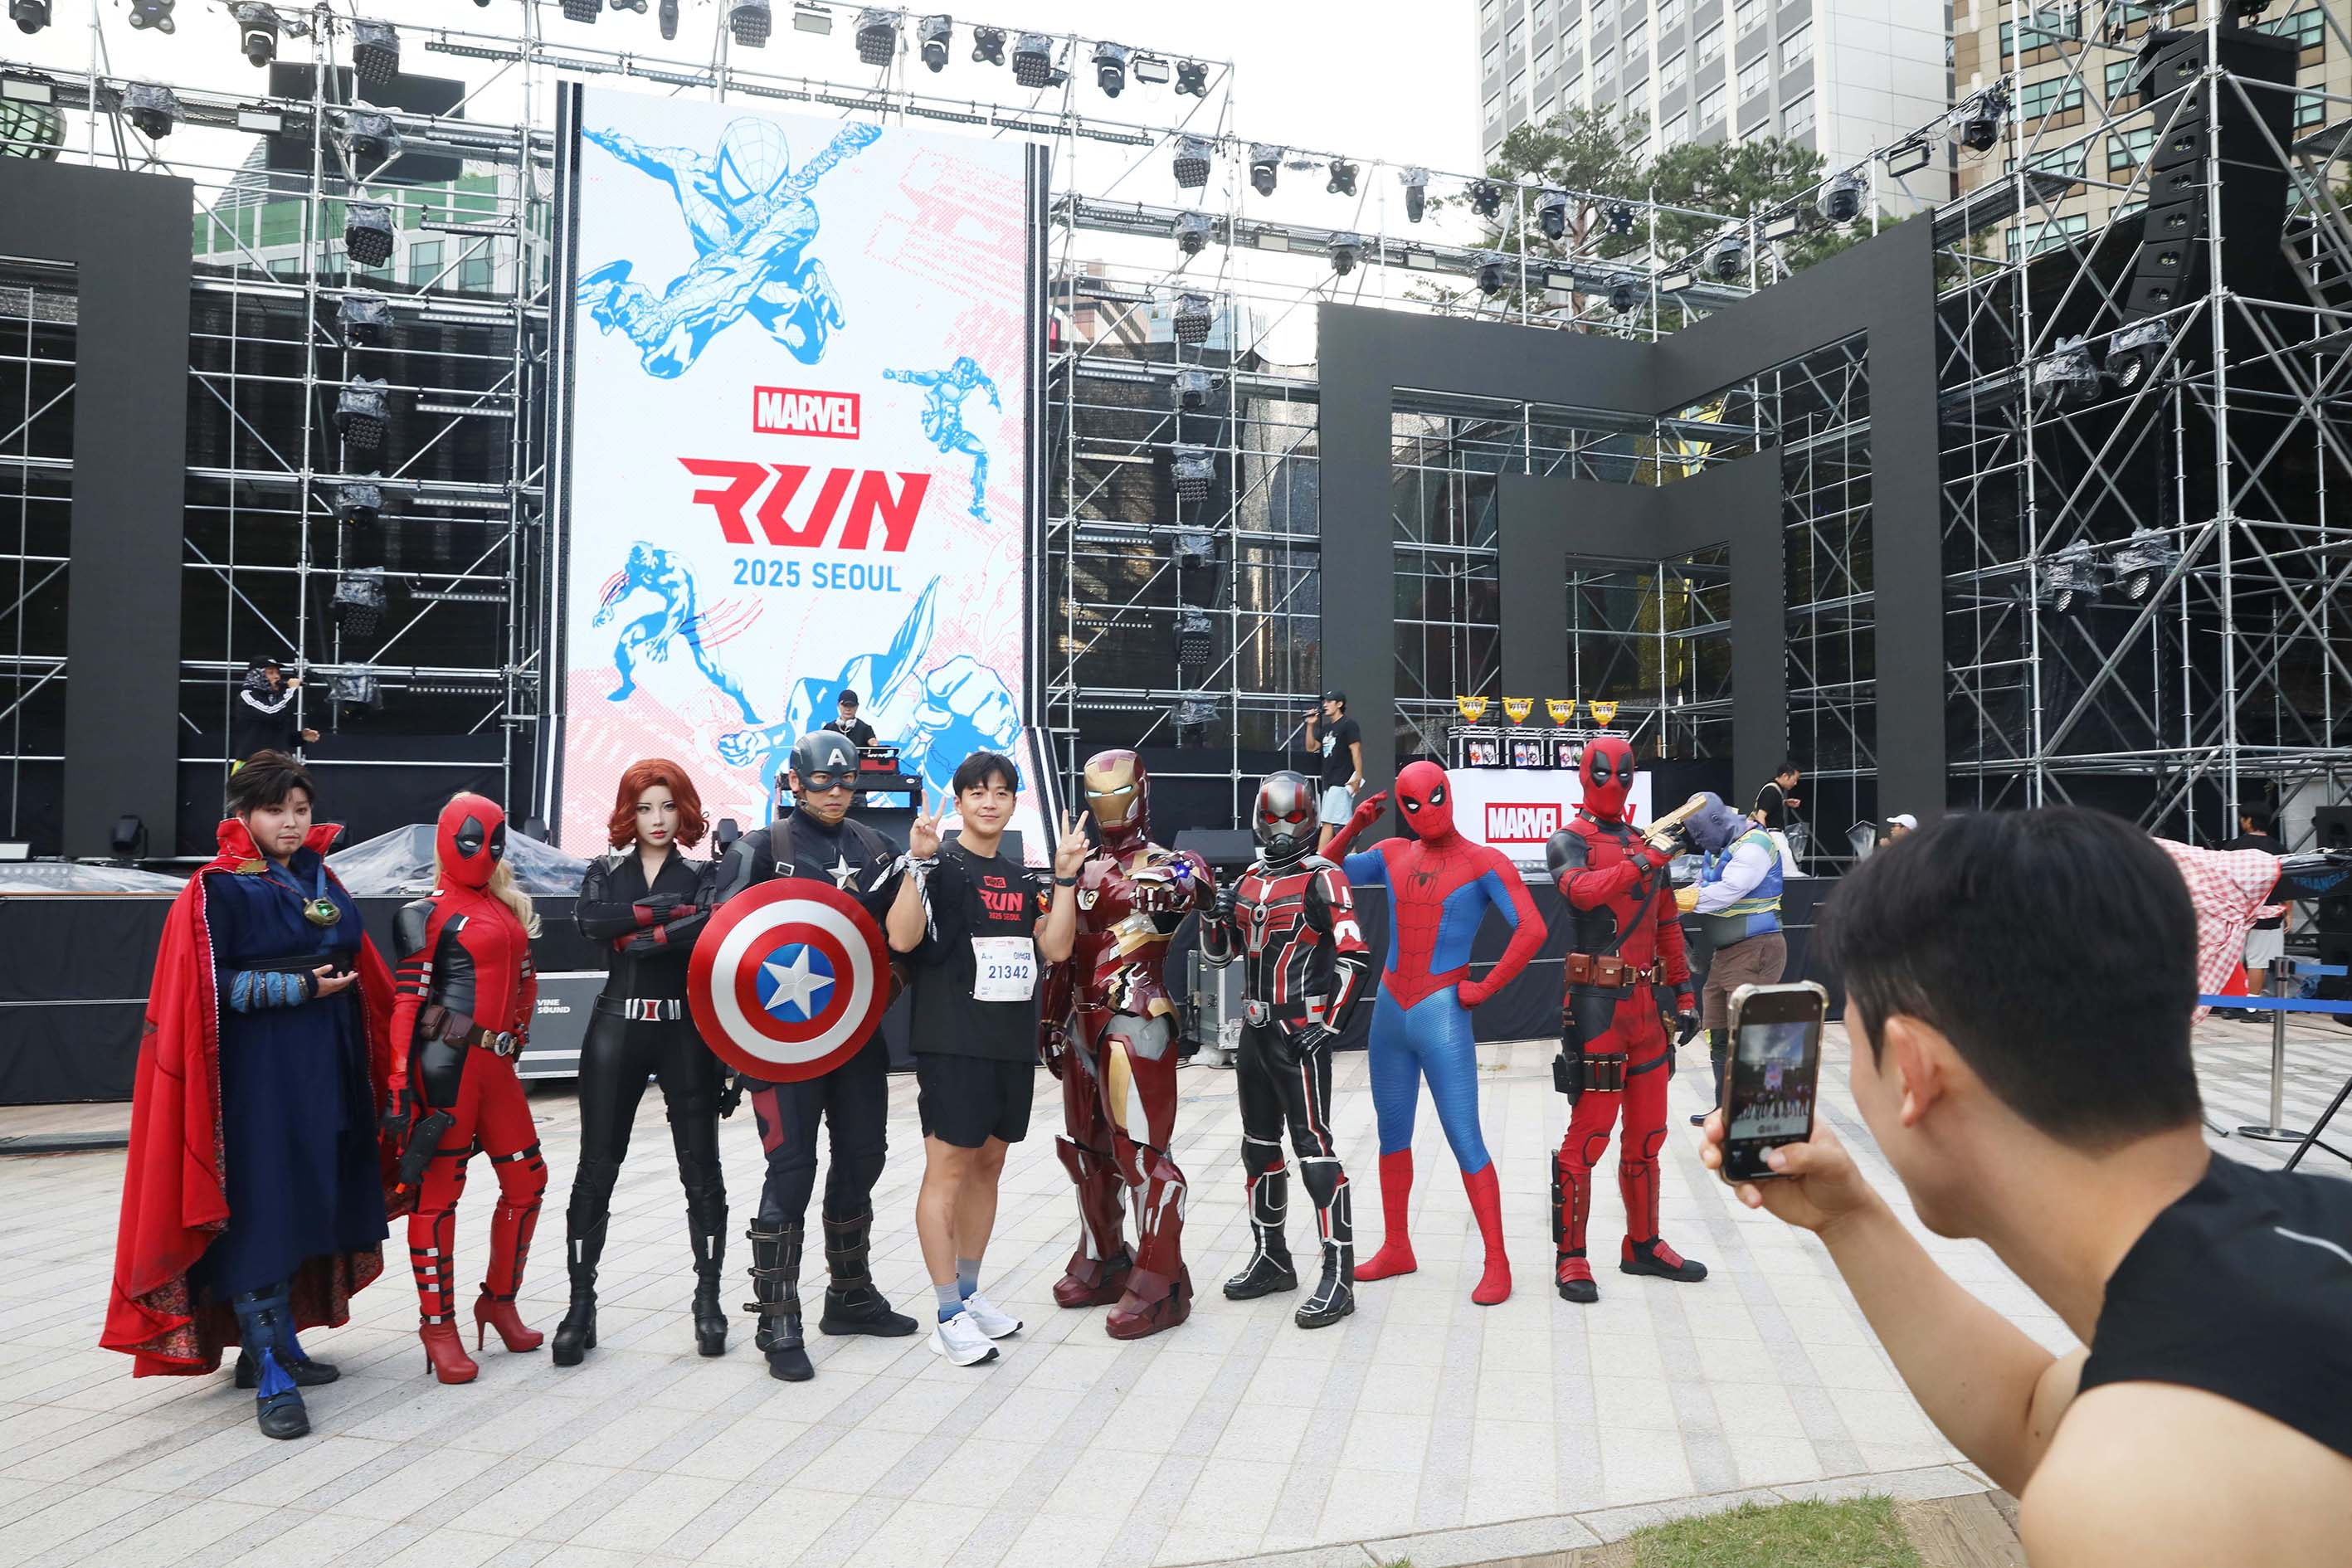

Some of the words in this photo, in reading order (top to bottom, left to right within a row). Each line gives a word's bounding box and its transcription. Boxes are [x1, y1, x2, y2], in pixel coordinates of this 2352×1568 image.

[757, 391, 857, 435] MARVEL
[677, 456, 932, 553] RUN
[733, 558, 801, 588] 2025
[811, 562, 902, 592] SEOUL
[826, 748, 848, 766] A
[977, 888, 1023, 912] RUN
[988, 965, 1029, 979] 21342
